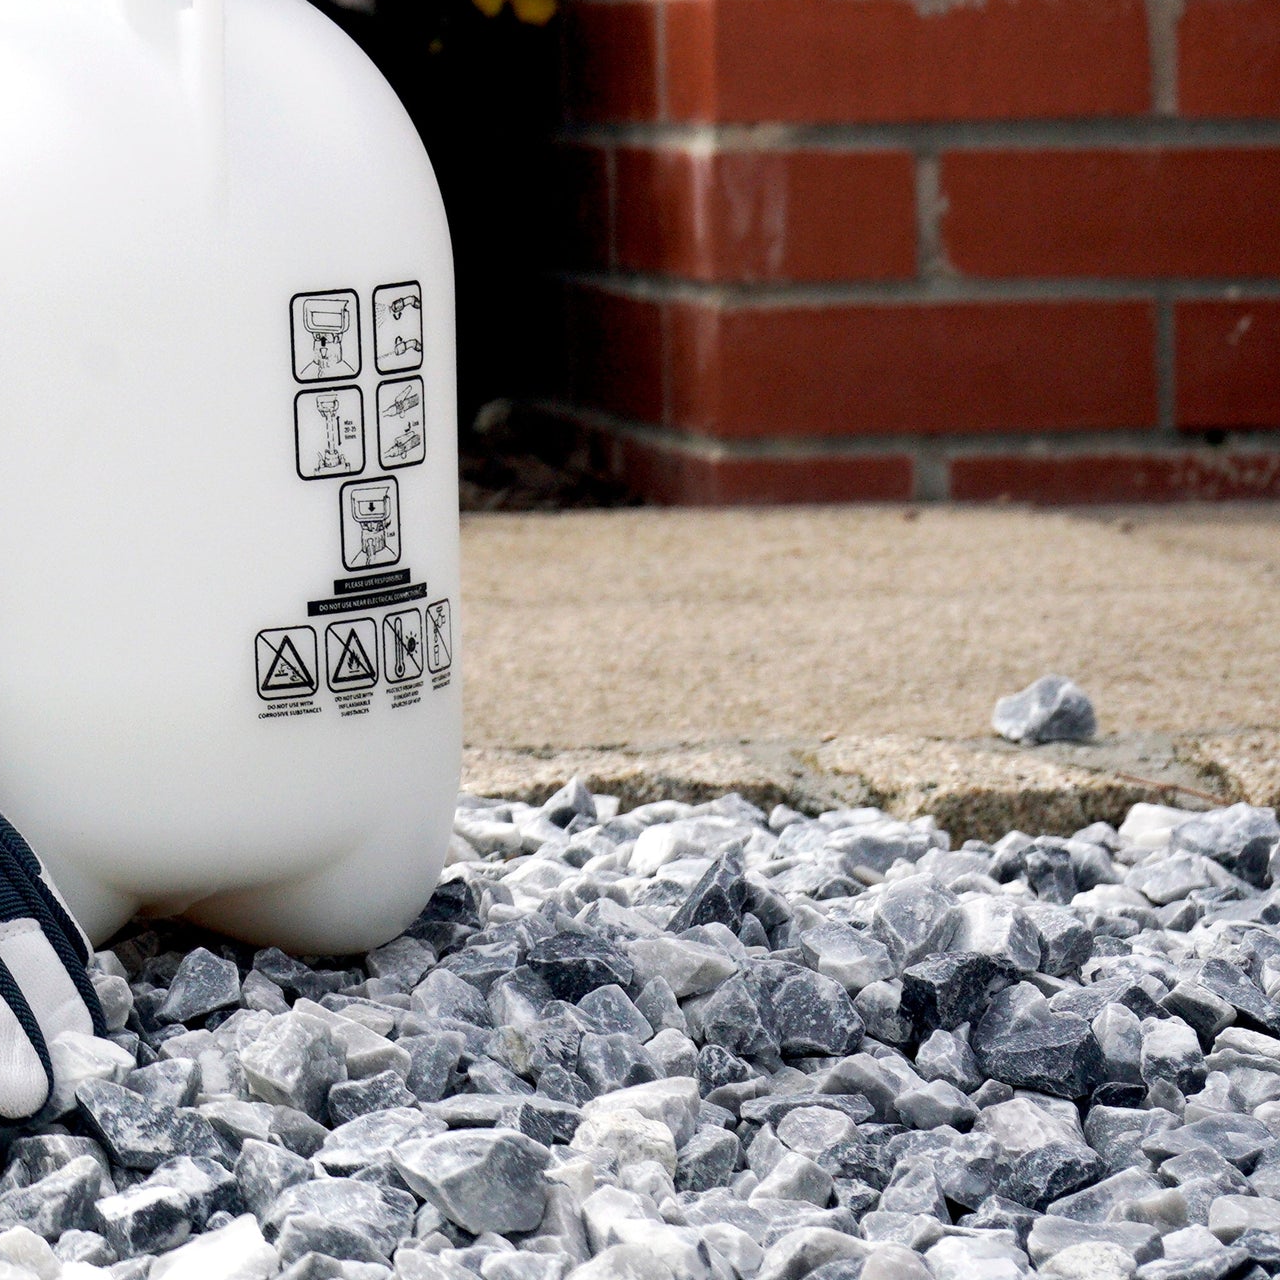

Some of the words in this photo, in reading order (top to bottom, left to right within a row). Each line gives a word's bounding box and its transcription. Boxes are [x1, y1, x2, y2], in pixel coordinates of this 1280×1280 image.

[345, 579, 364, 589] PLEASE
[365, 578, 374, 587] USE
[319, 604, 329, 612] DO
[329, 602, 341, 610] NOT
[342, 600, 352, 609] USE
